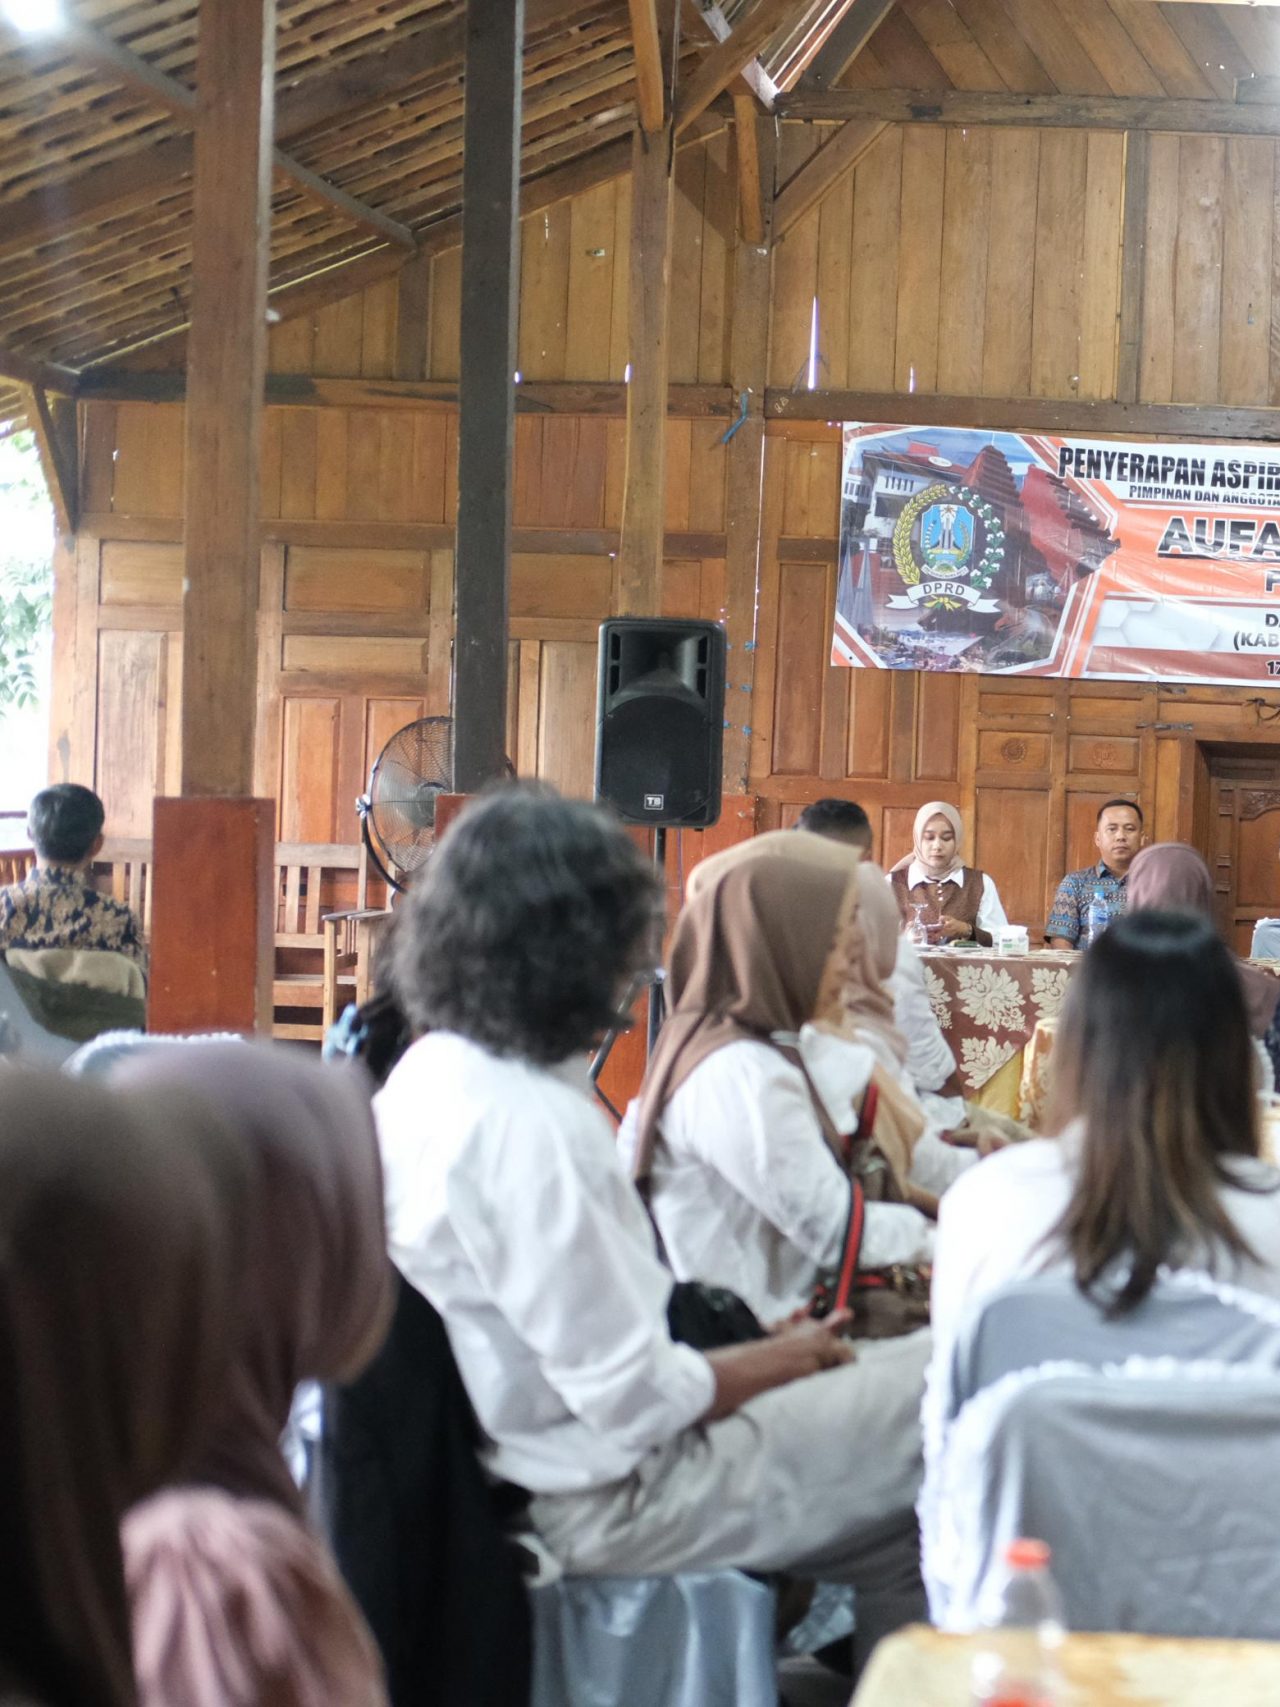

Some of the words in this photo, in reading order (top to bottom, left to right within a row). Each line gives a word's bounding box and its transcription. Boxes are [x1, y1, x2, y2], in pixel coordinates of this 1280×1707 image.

[1058, 447, 1206, 487] PENYERAPAN
[1129, 485, 1191, 500] PIMPINAN
[1195, 490, 1219, 503] DAN
[1222, 492, 1280, 507] ANGGOTA
[923, 582, 965, 596] DPRD
